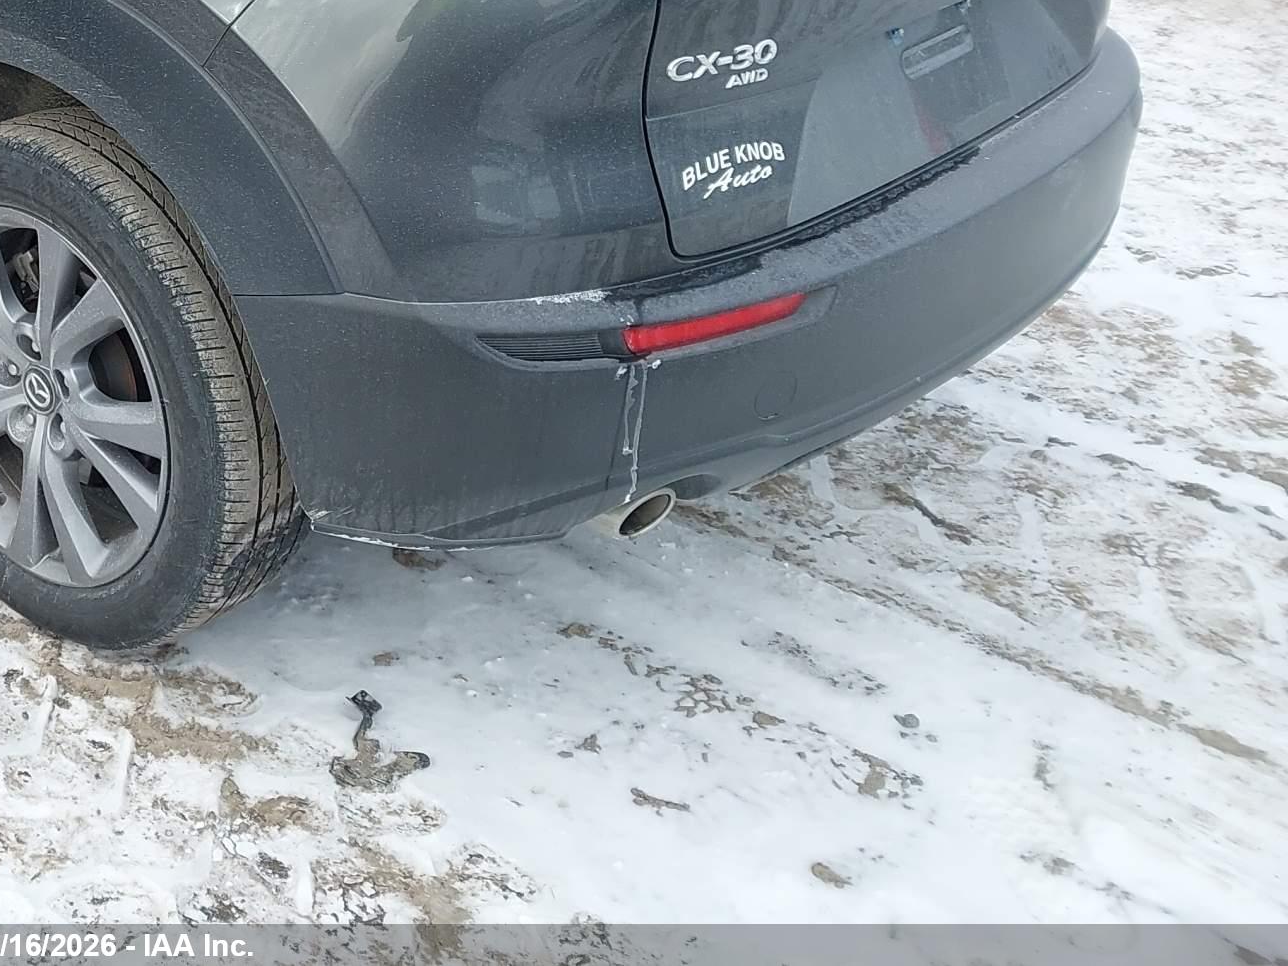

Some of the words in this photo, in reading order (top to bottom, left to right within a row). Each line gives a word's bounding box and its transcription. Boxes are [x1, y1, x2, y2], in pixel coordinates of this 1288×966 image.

[666, 38, 778, 82] CX-30
[725, 68, 769, 89] AWD
[682, 148, 732, 191] BLUE
[734, 141, 785, 165] KNOB
[703, 164, 773, 199] Auto
